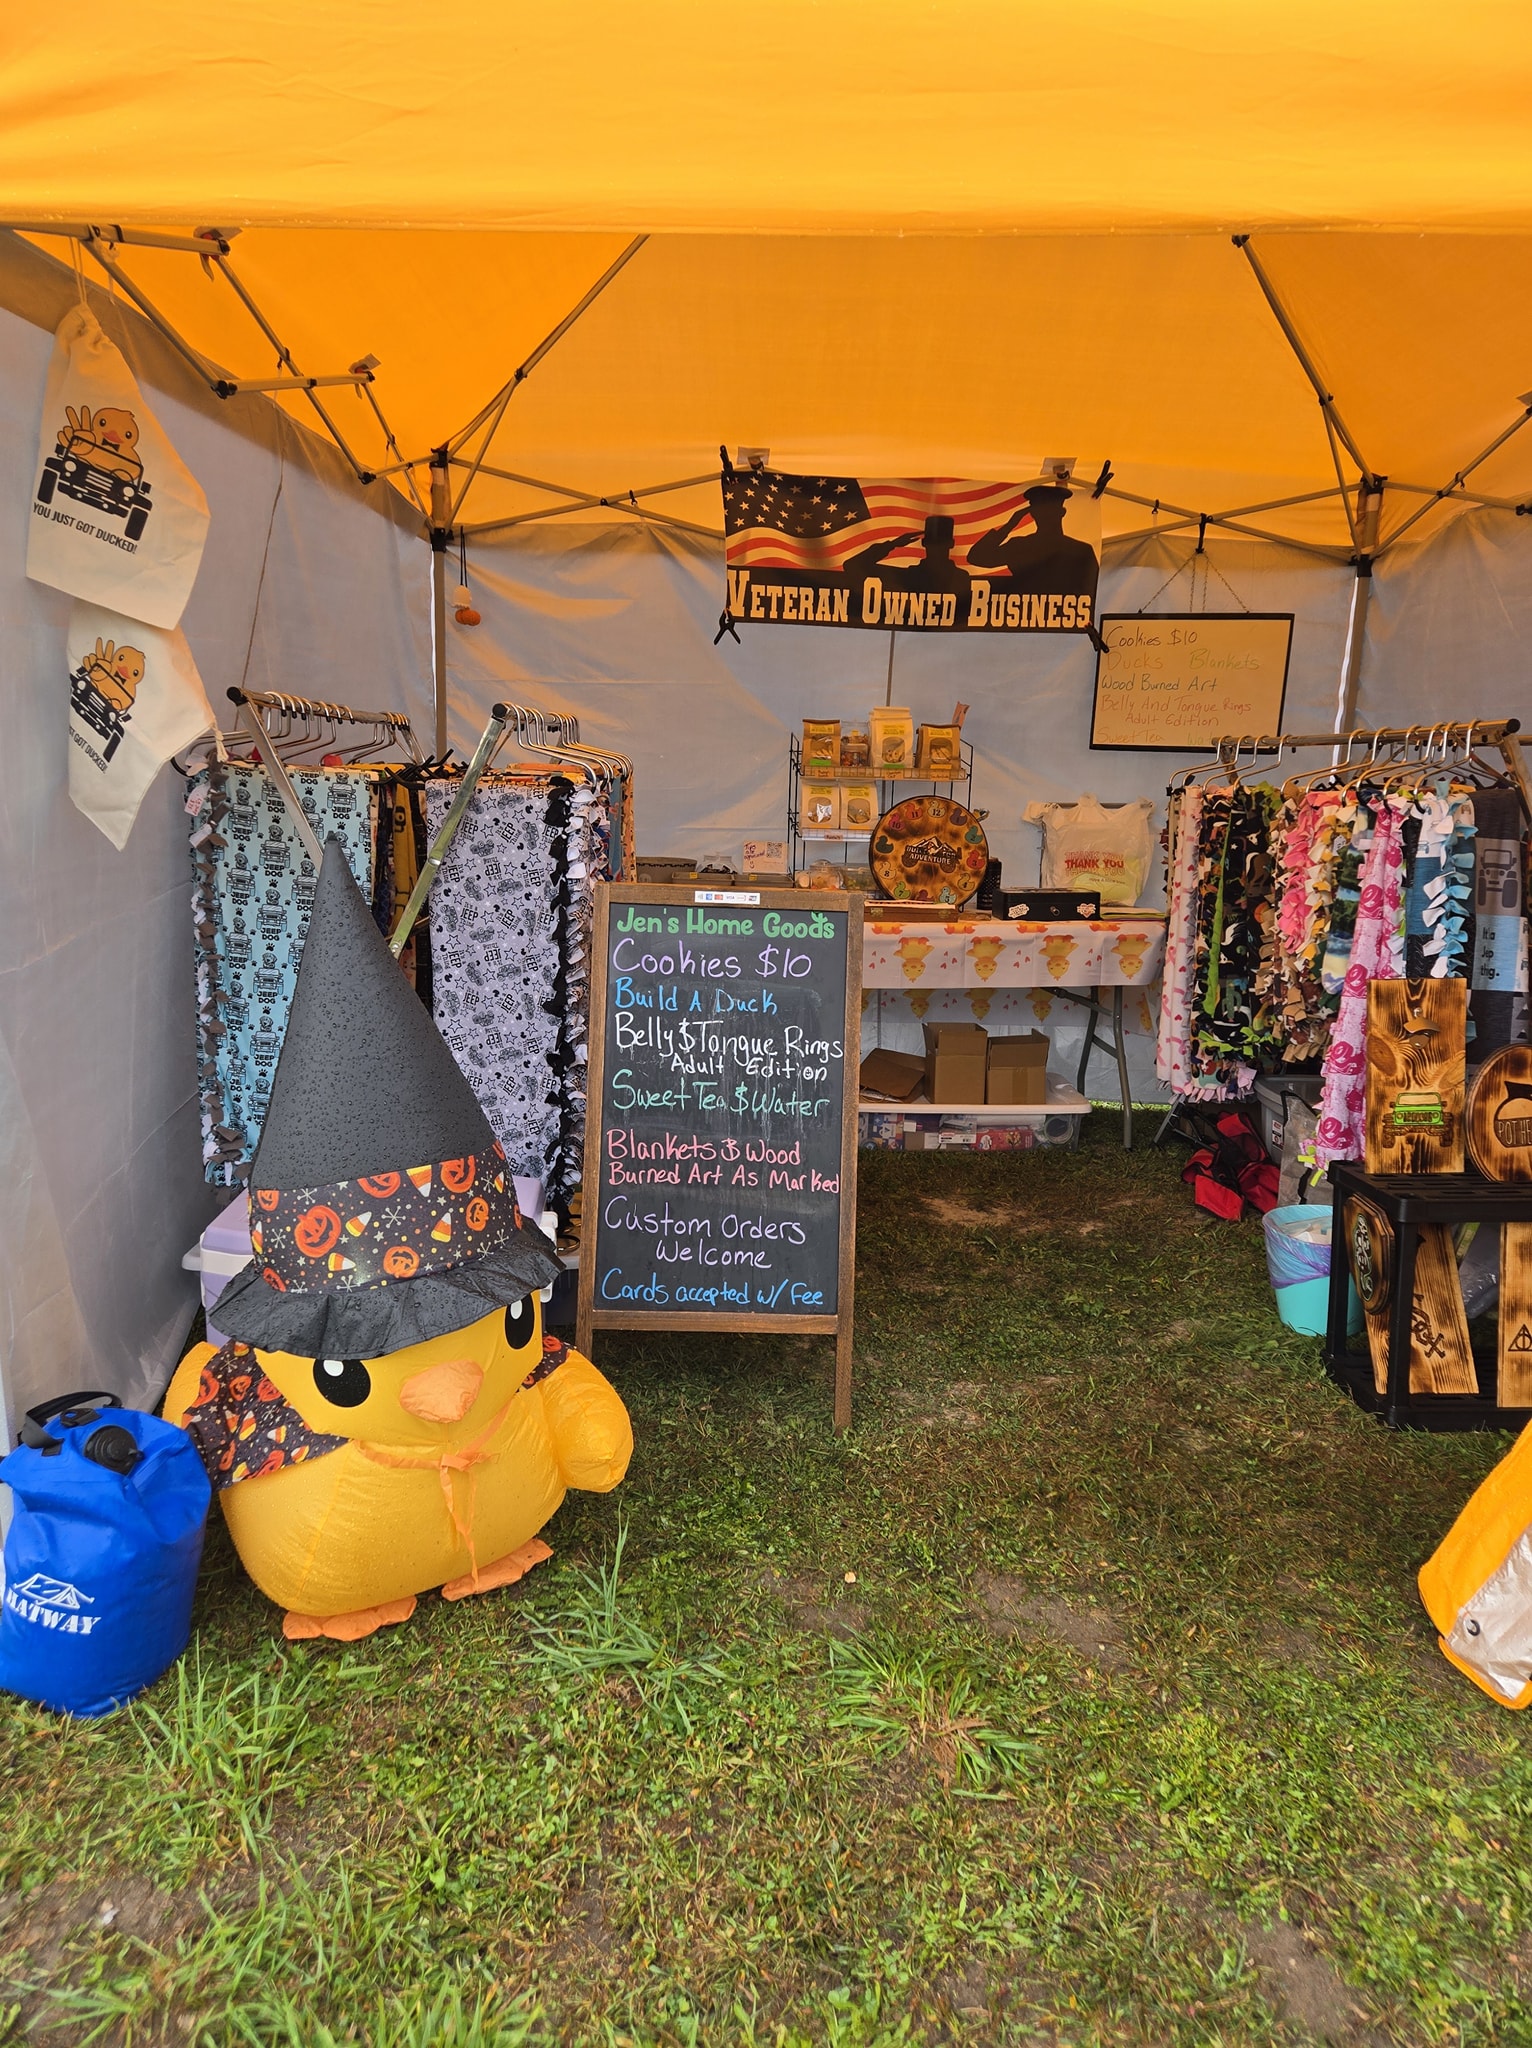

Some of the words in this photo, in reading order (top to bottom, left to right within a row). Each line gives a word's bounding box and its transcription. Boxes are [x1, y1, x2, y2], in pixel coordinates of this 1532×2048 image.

[33, 502, 51, 518] YOU
[51, 511, 76, 527] JUST
[76, 520, 96, 535] GOT
[96, 528, 137, 554] DUCKED!
[728, 570, 849, 621] VETERAN
[862, 577, 956, 625] OWNED
[968, 579, 1090, 628] BUSINESS
[1106, 626, 1161, 648] Cookies
[1167, 629, 1198, 646] $10
[1106, 651, 1163, 670] Ducks
[1188, 649, 1260, 670] Blankets
[1101, 674, 1134, 690] Wood
[1140, 674, 1180, 690] Burned
[1187, 679, 1217, 691] Art
[1101, 694, 1134, 711] Belly
[1141, 695, 1169, 711] And
[1175, 695, 1218, 717] Tongue
[1223, 698, 1251, 715] Rings
[1125, 712, 1159, 725] Adult
[1166, 713, 1220, 726] Edition
[74, 733, 87, 749] GOT
[333, 812, 350, 820] DOG
[892, 821, 900, 829] 10
[461, 822, 478, 835] JEEP
[501, 822, 516, 843] JEEP
[542, 825, 559, 838] JEEP
[909, 853, 951, 864] ADVENTURE
[1065, 860, 1100, 868] THANK
[1103, 860, 1124, 868] YOU
[447, 864, 460, 883] JEEP
[484, 863, 501, 876] JEEP
[528, 869, 541, 887] JEEP
[231, 891, 250, 899] JEEP
[232, 898, 248, 906] DOG
[460, 908, 479, 921] JEEP
[501, 909, 516, 929] JEEP
[616, 908, 679, 934] Jen's
[686, 908, 754, 935] Home
[763, 912, 835, 939] Goods
[448, 950, 462, 968] JEEP
[484, 948, 501, 962] JEEP
[526, 954, 539, 972] JEEP
[612, 938, 741, 978] Cookies
[755, 943, 812, 978] $10
[229, 962, 246, 970] DOG
[463, 994, 480, 1005] JEEP
[501, 994, 515, 1013] JEEP
[615, 977, 678, 1012] Build
[689, 990, 702, 1012] A
[715, 988, 778, 1016] Duck
[450, 1034, 464, 1052] JEEP
[486, 1033, 502, 1046] JEEP
[526, 1038, 540, 1055] JEEP
[615, 1011, 674, 1057] Belly
[692, 1020, 778, 1066] Tongue
[784, 1026, 844, 1063] Rings
[671, 1053, 724, 1075] Adult
[746, 1057, 828, 1081] Edition
[502, 1076, 516, 1096] JEEP
[612, 1069, 692, 1110] Sweet
[692, 1082, 726, 1110] Tea
[751, 1087, 830, 1117] Water
[528, 1118, 542, 1136] JEEP
[1498, 1121, 1517, 1144] POT
[1520, 1120, 1532, 1144] HE
[607, 1128, 717, 1160] Blankets
[746, 1140, 800, 1165] Wood
[608, 1161, 681, 1186] Burned
[687, 1162, 723, 1185] Art
[731, 1164, 759, 1188] As
[604, 1195, 711, 1238] Custom
[721, 1214, 806, 1245] Orders
[656, 1238, 772, 1269] Welcome
[601, 1267, 669, 1305] Cards
[675, 1281, 751, 1306] accepted
[757, 1278, 789, 1308] w/
[790, 1282, 824, 1306] Fee
